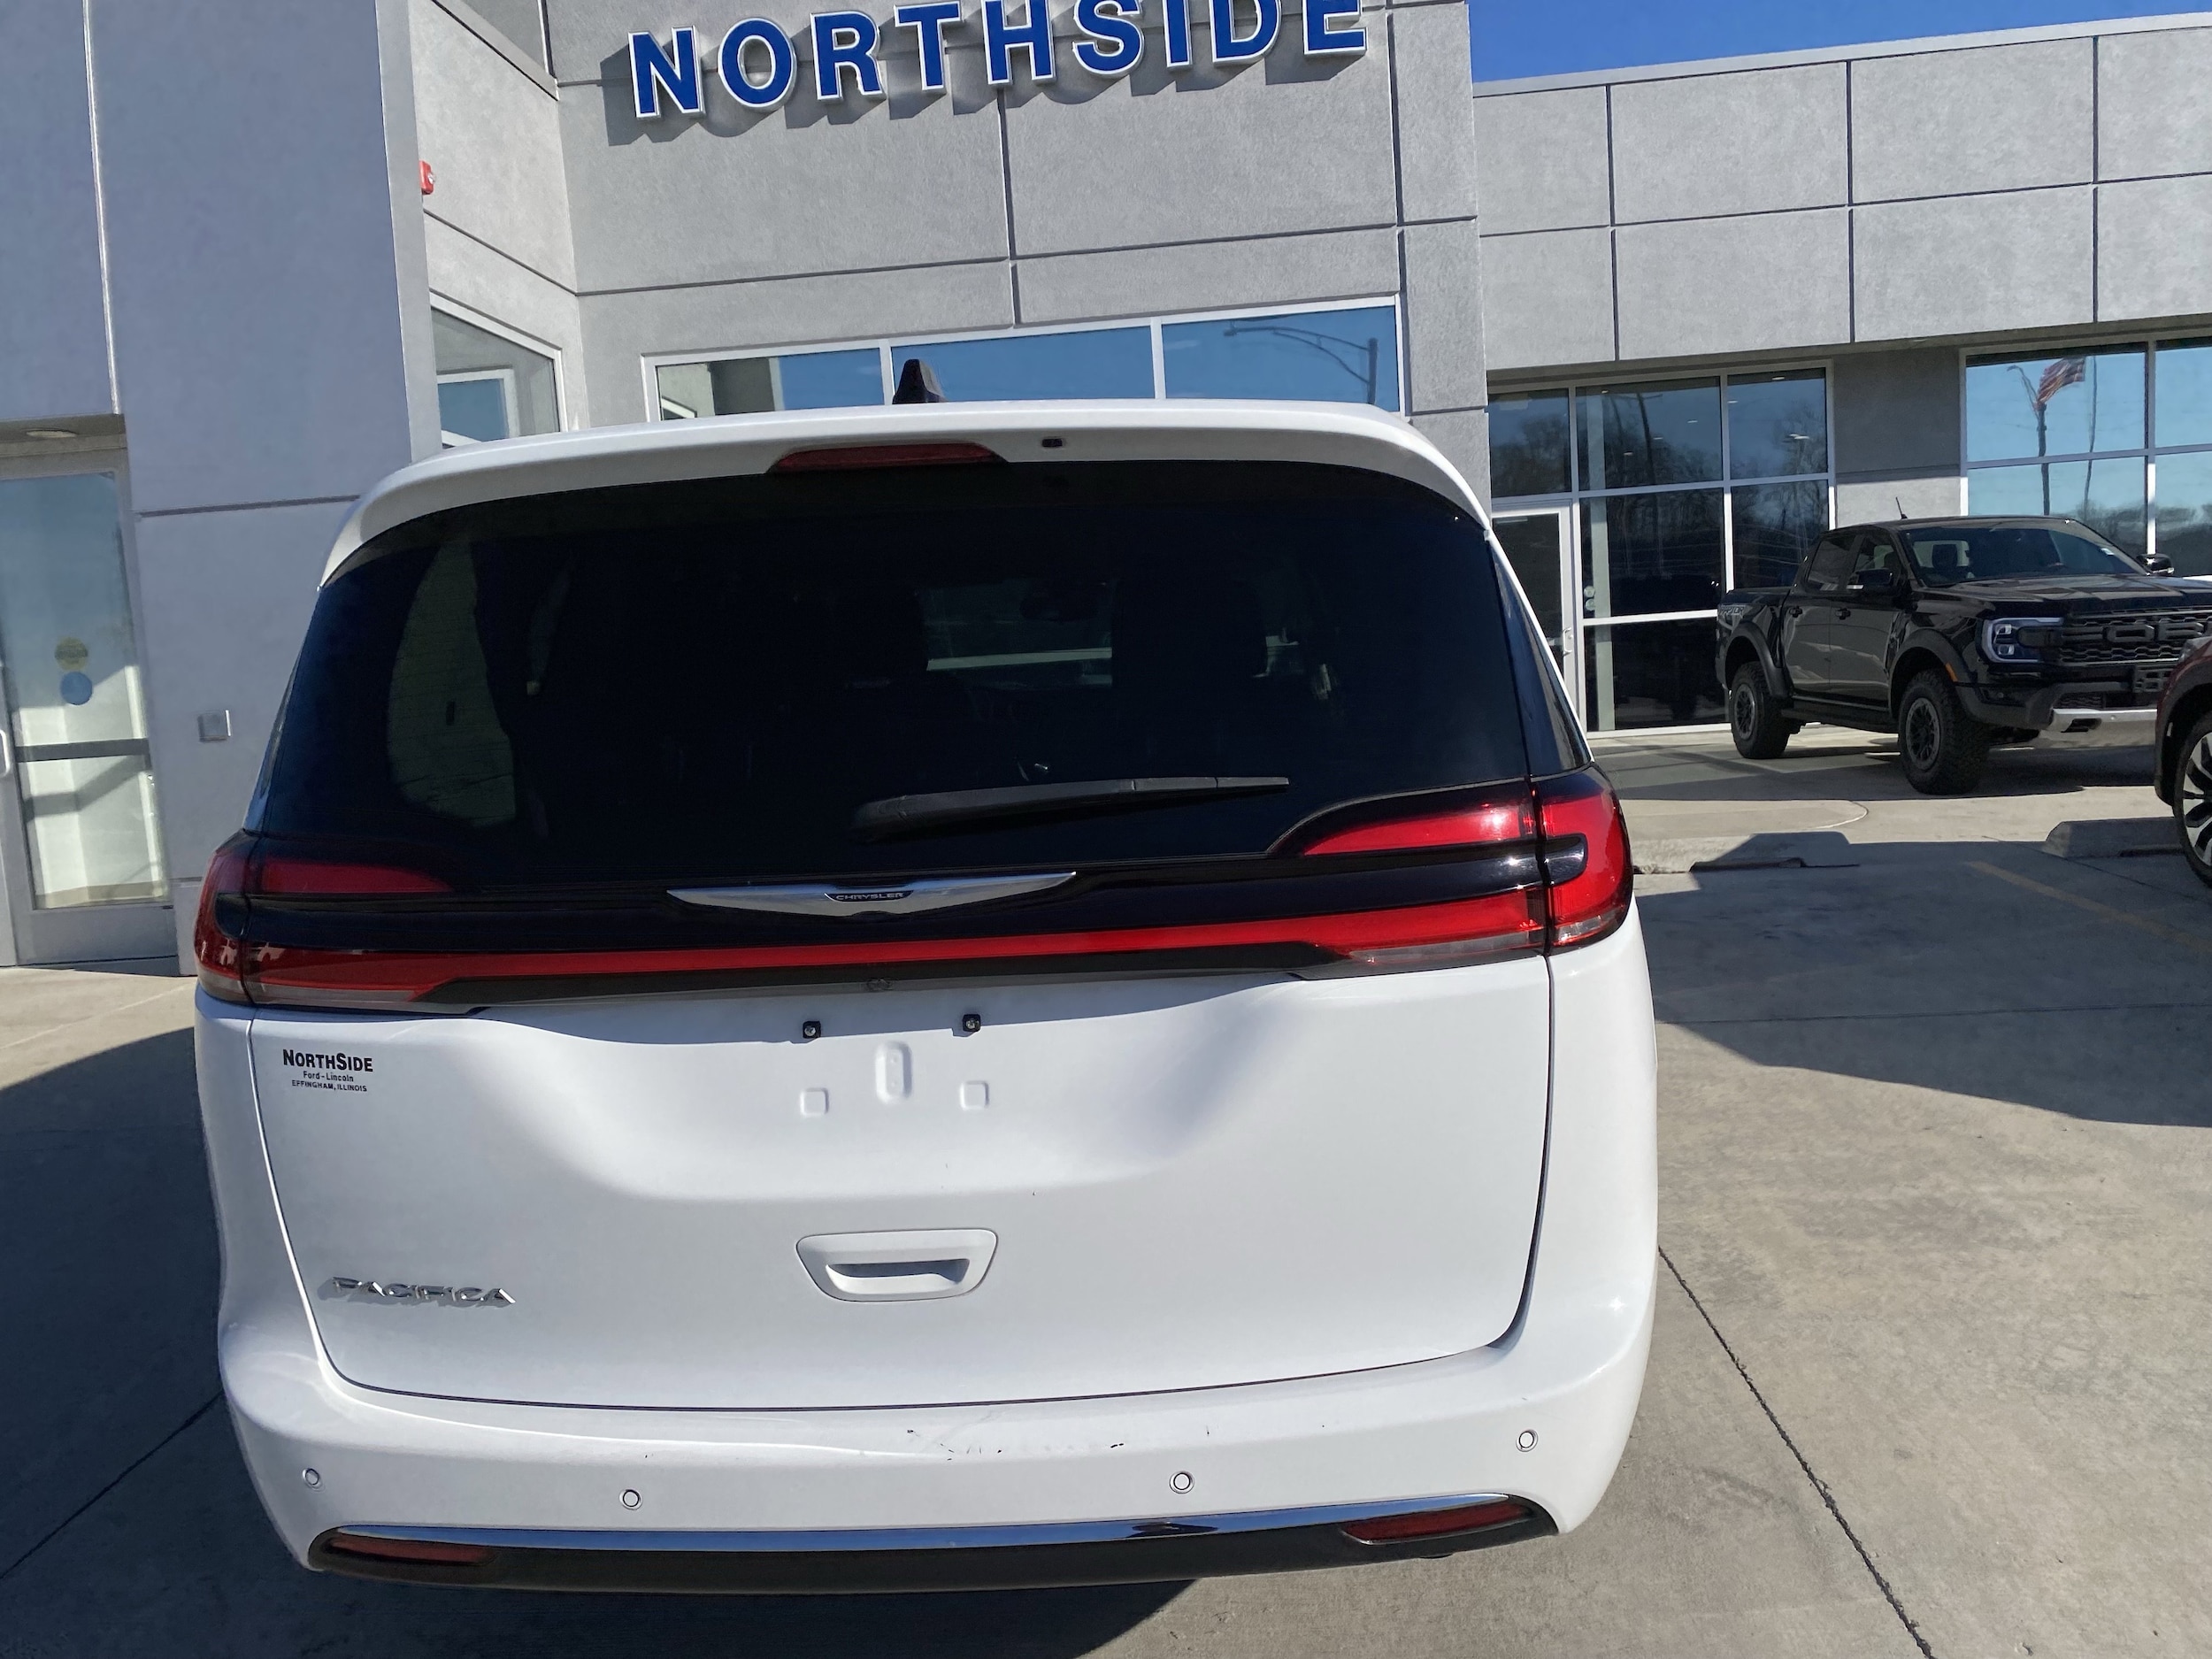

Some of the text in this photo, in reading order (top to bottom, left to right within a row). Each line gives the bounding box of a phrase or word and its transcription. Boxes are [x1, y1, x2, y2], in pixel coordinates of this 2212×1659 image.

[626, 0, 1367, 119] NORTHSIDE
[835, 892, 904, 901] CHRYSLER
[291, 1079, 336, 1091] EFFINGHAM,
[330, 1276, 517, 1305] PACIFICA
